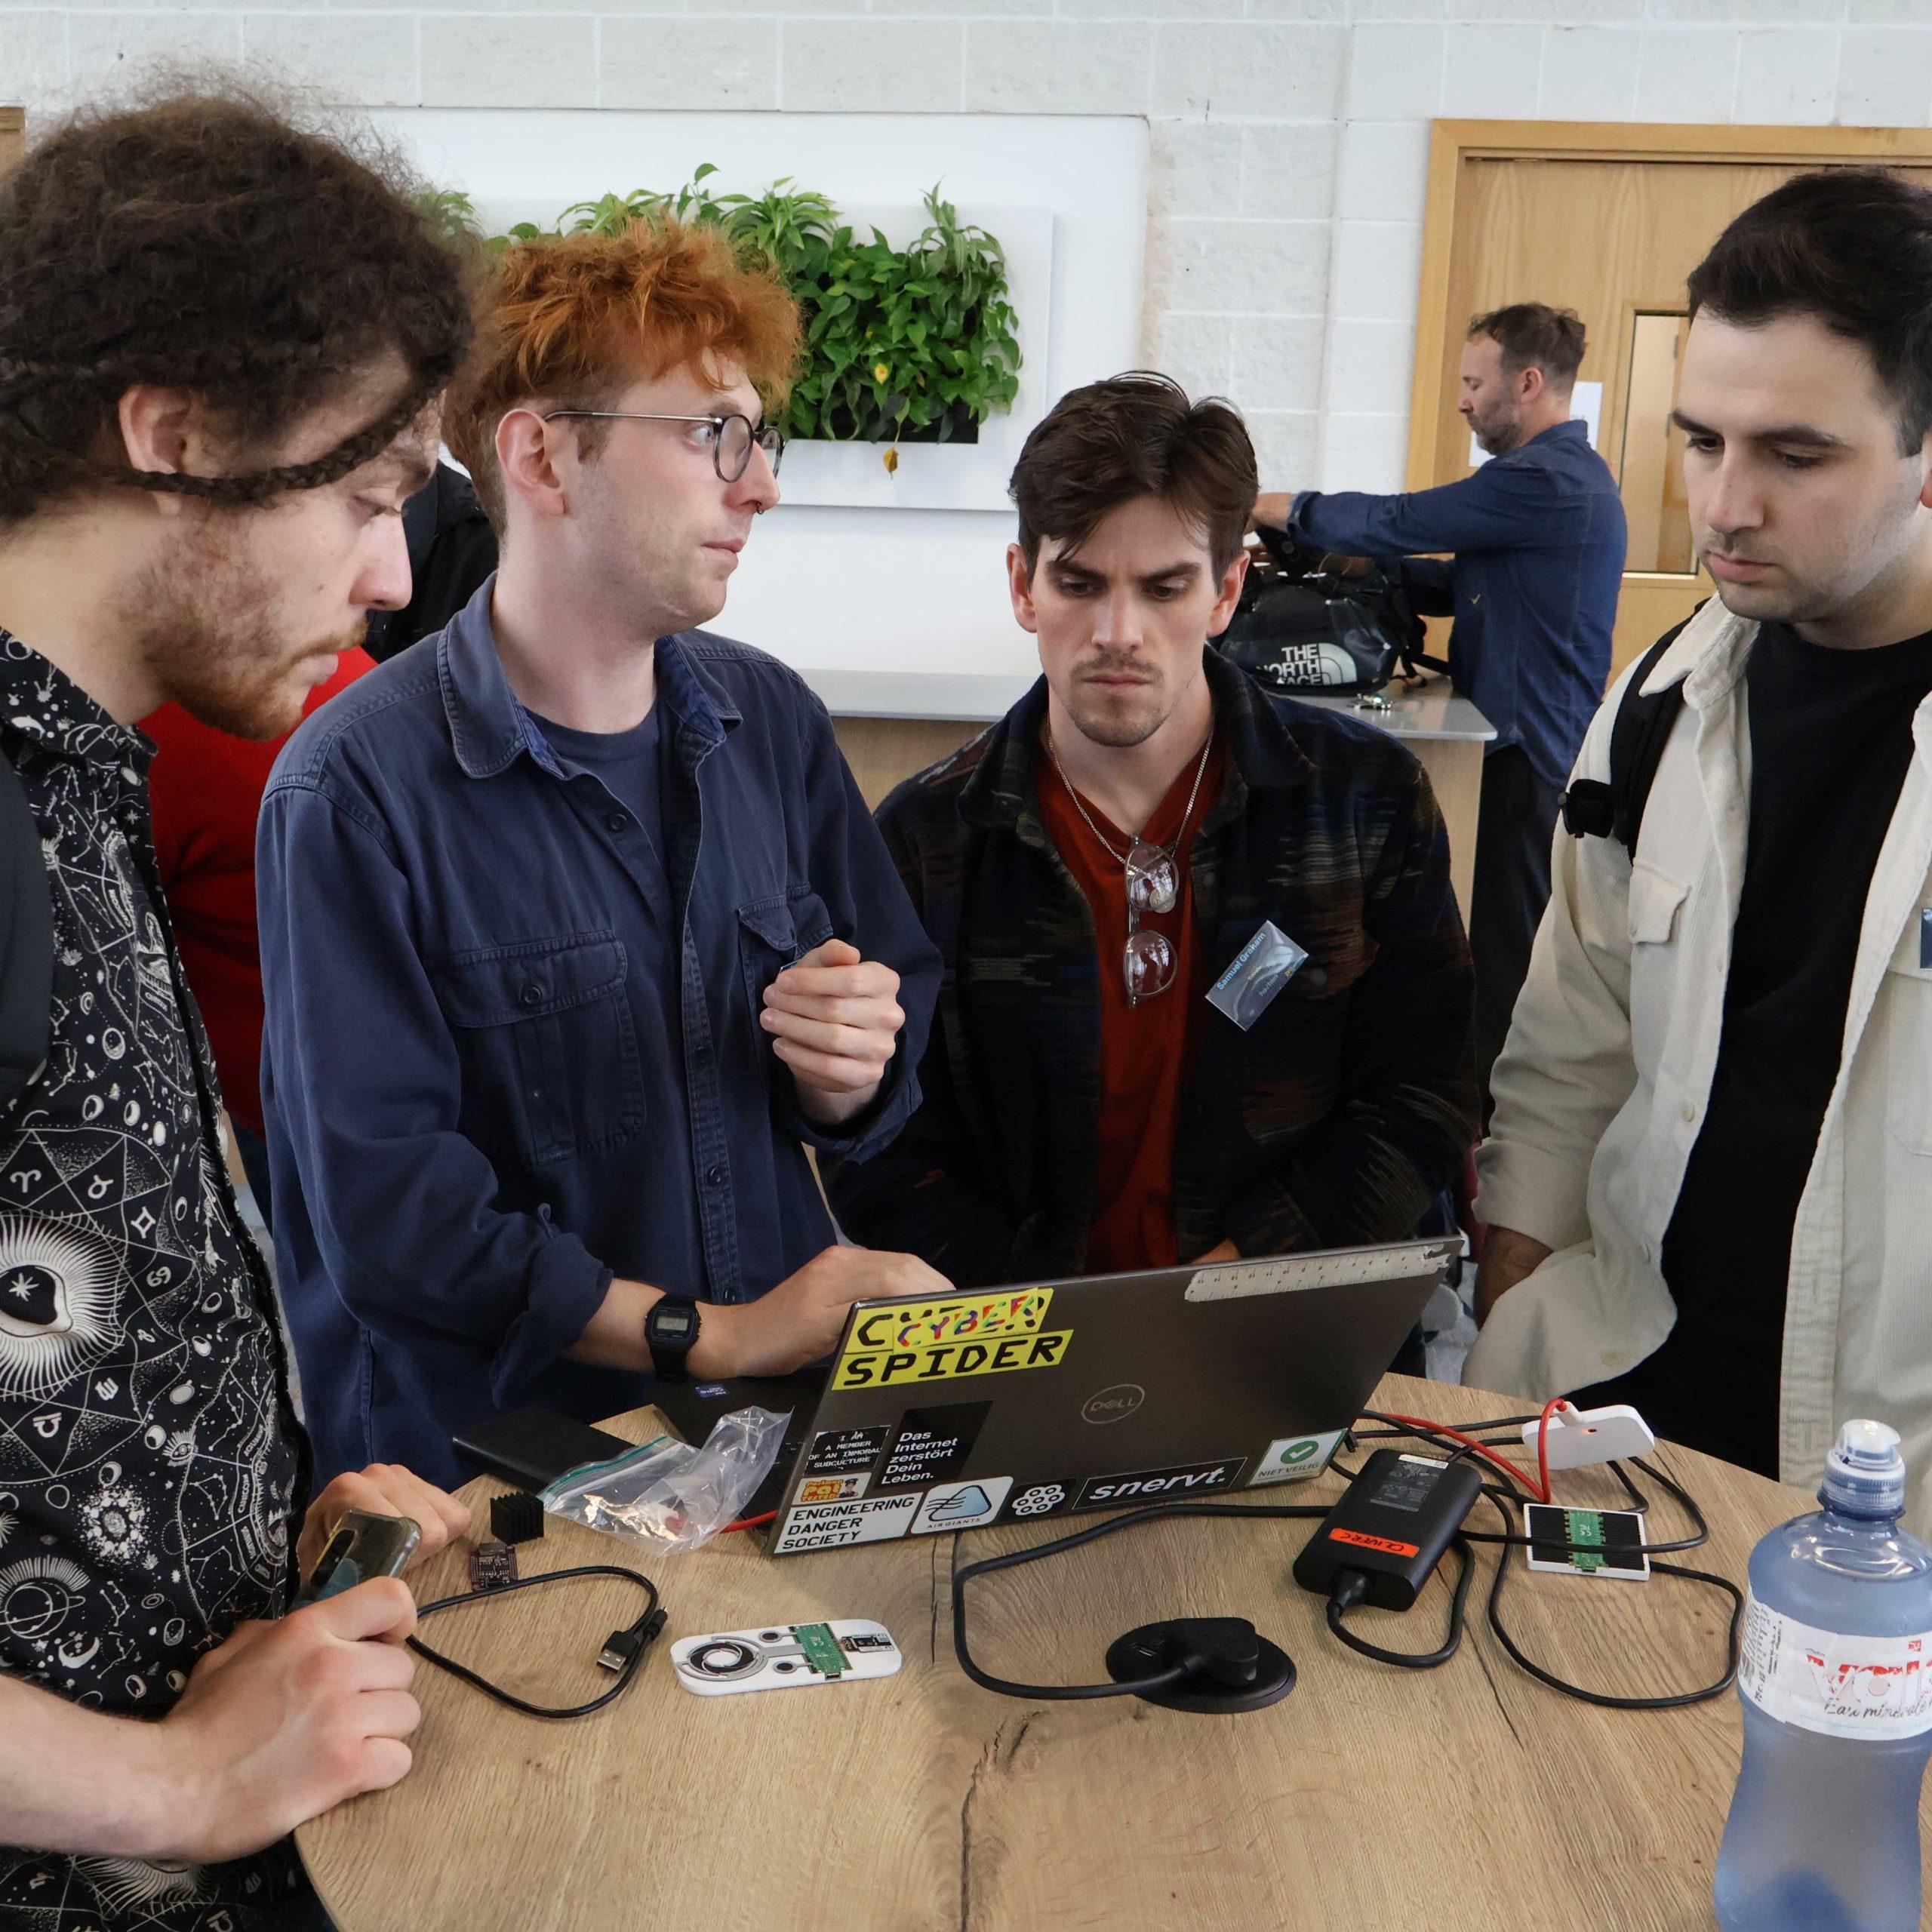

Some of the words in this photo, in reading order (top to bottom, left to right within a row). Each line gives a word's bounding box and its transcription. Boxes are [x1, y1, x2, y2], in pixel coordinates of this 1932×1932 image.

[1281, 644, 1319, 662] THE
[1256, 659, 1320, 678] ORTH
[1217, 957, 1242, 990] Samuel
[1239, 932, 1266, 962] Graham
[843, 1335, 1063, 1386] SPIDER
[1091, 1398, 1134, 1411] DELL
[900, 1432, 931, 1442] Das
[837, 1441, 872, 1450] MEMBER
[843, 1447, 881, 1457] IMMORAL
[895, 1438, 958, 1453] Internet
[814, 1457, 871, 1468] SUBCULTURE
[889, 1448, 954, 1464] zerstört
[886, 1463, 923, 1474] Dein
[1259, 1468, 1282, 1477] NIET
[1286, 1463, 1319, 1472] VEILIG
[881, 1472, 934, 1484] Leben.
[1089, 1466, 1226, 1501] snervt.
[793, 1497, 915, 1521] ENGINEERING
[788, 1518, 863, 1535] DANGER
[946, 1517, 980, 1526] GIANTS
[783, 1531, 862, 1549] SOCIETY
